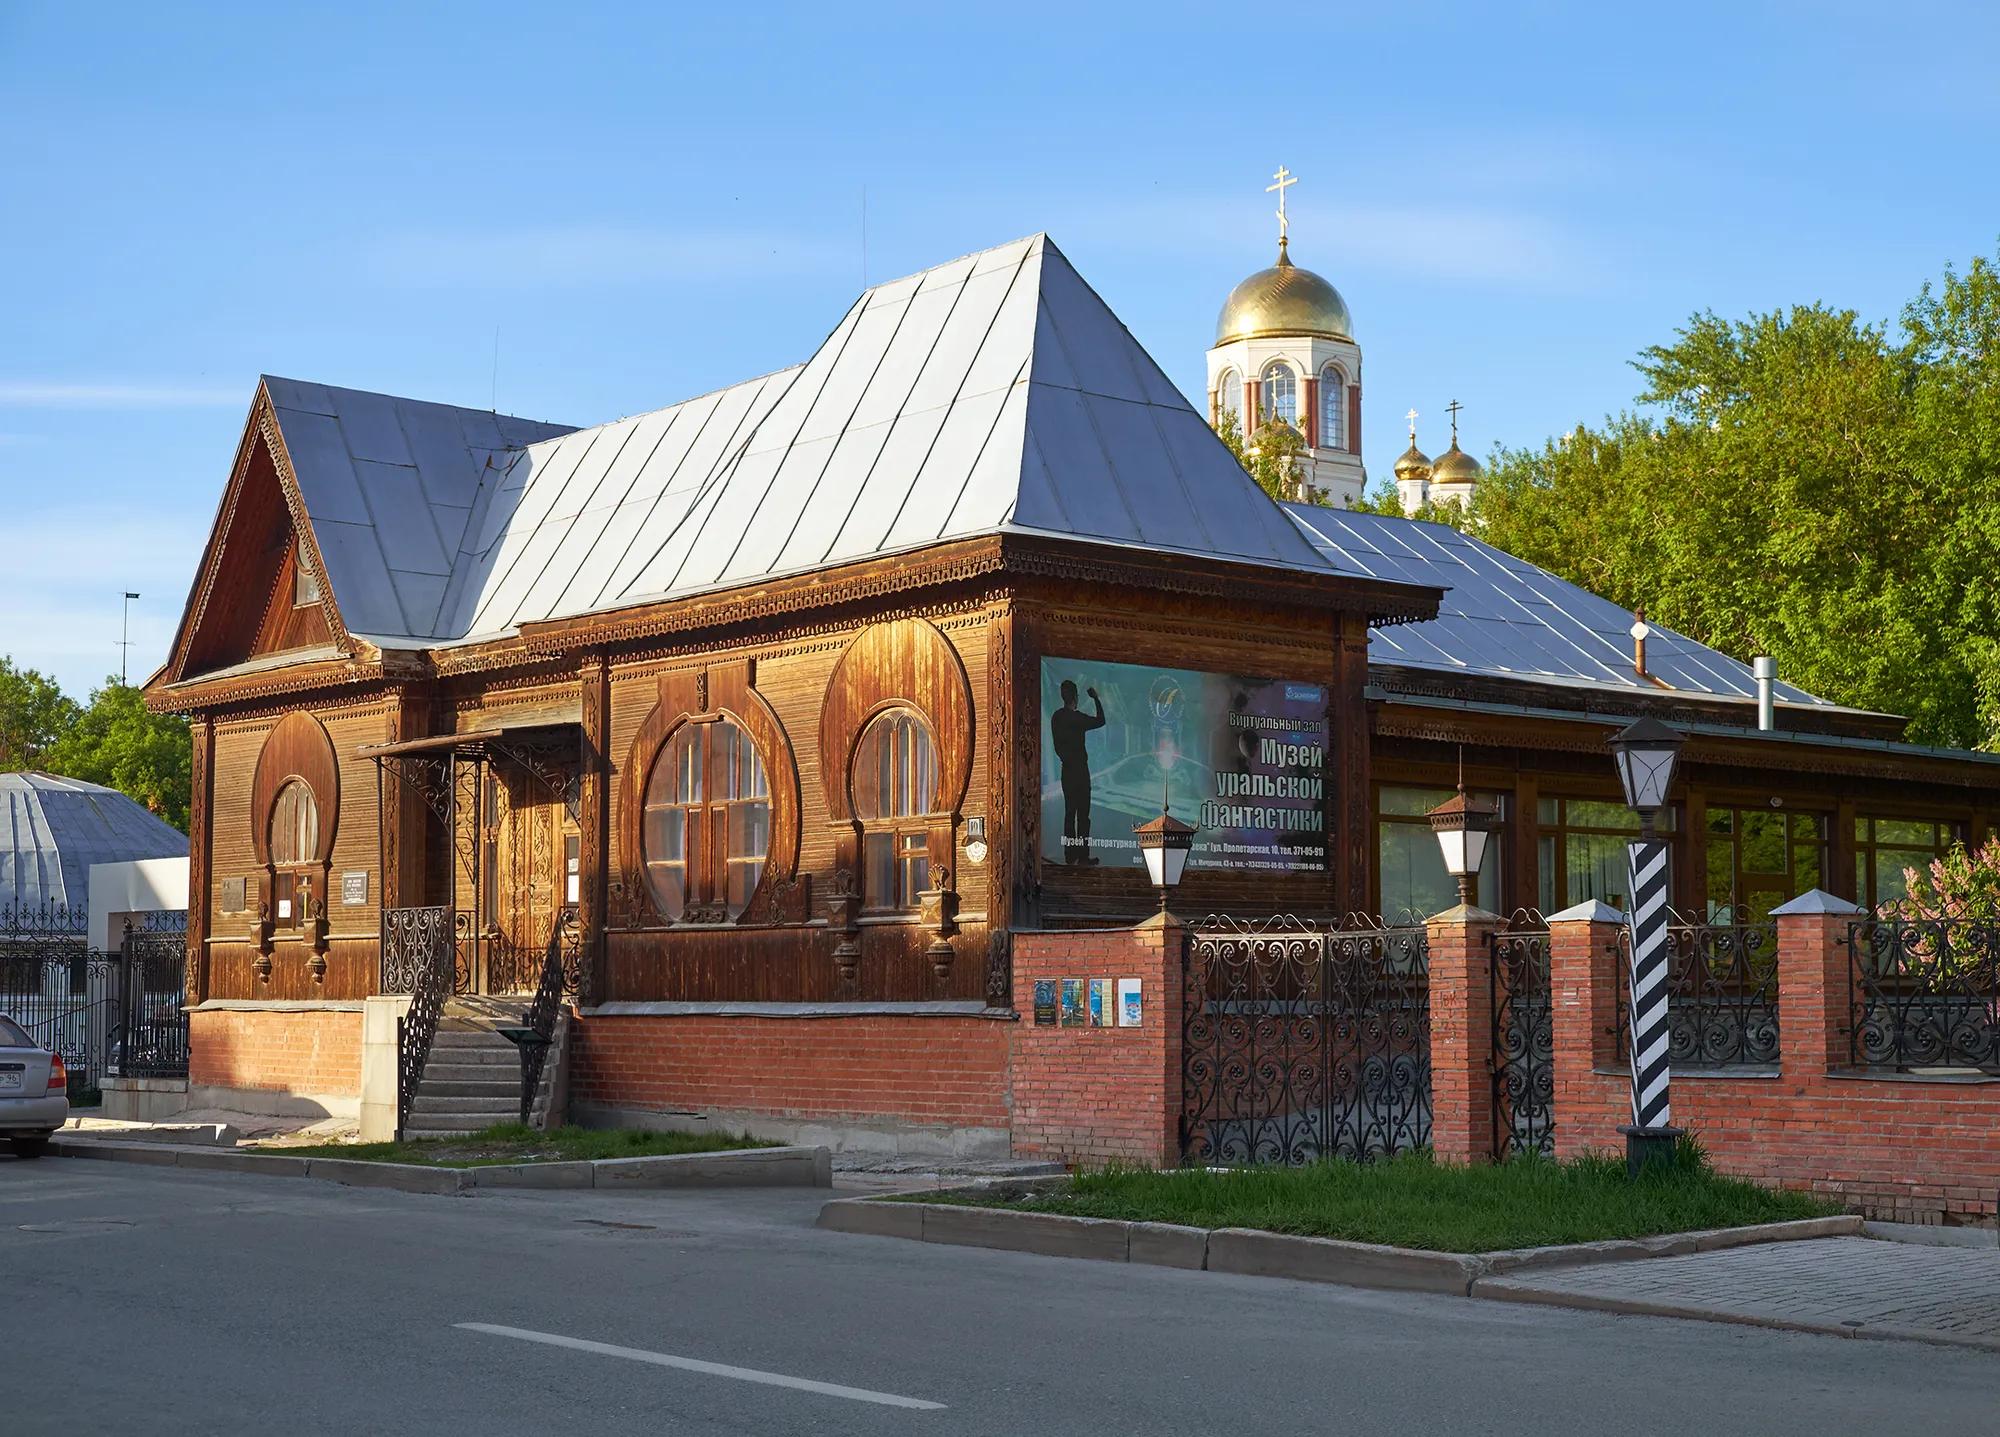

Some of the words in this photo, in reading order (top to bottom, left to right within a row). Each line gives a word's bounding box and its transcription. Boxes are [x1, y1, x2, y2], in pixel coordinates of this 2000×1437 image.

[1303, 720, 1321, 733] зал
[1261, 738, 1322, 767] Музей
[1216, 772, 1322, 799] уральской
[1201, 801, 1322, 831] фантастики
[1060, 835, 1084, 847] Музей
